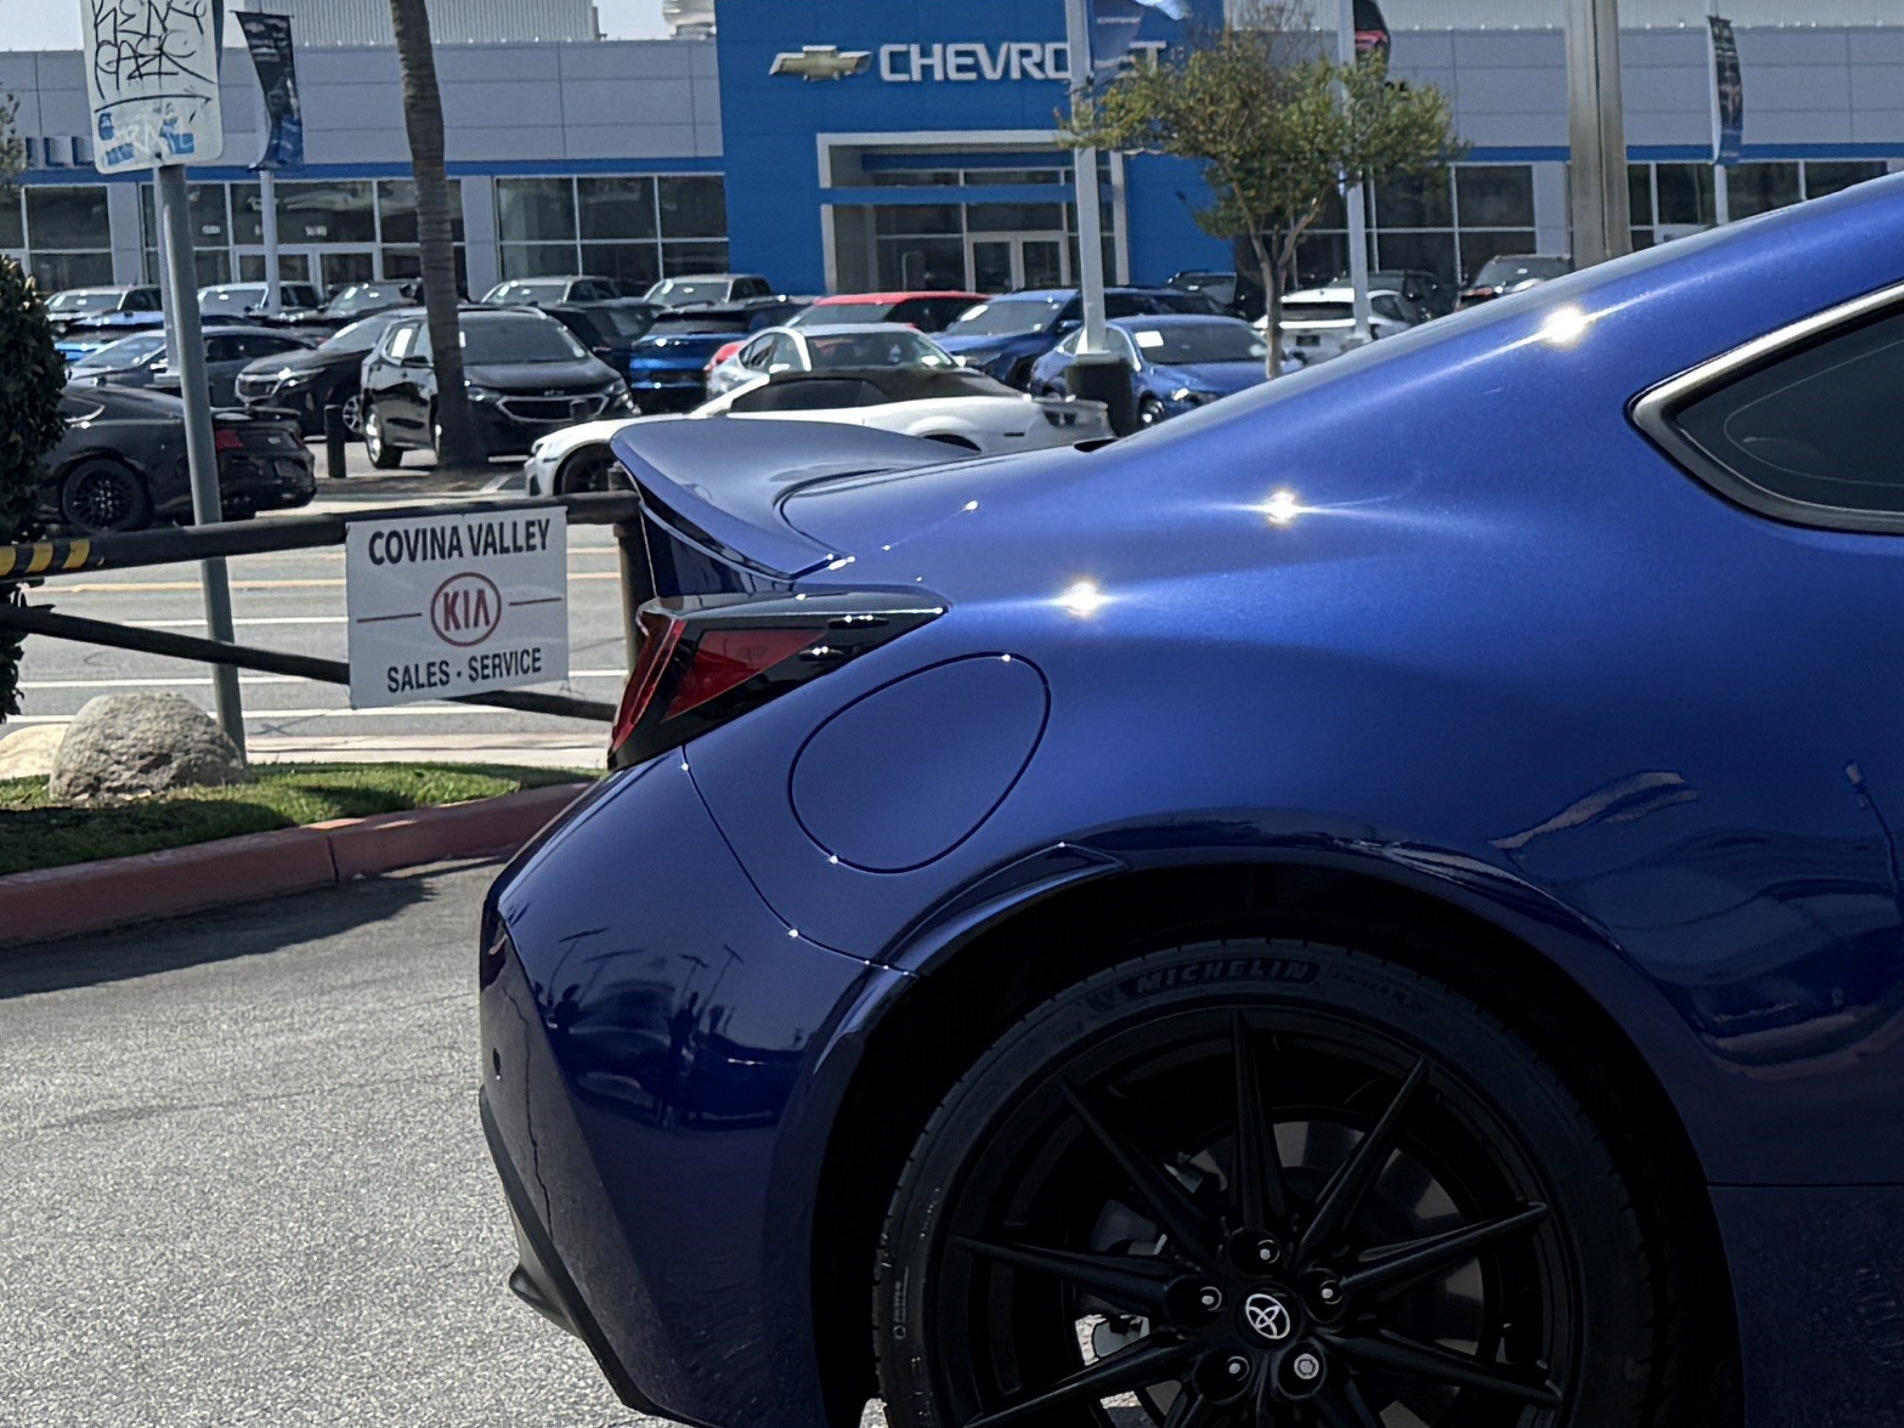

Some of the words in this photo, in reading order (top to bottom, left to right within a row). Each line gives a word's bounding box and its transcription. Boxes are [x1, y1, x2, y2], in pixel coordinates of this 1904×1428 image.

[879, 40, 1168, 82] CHEVROT
[368, 526, 464, 566] COVINA
[467, 518, 550, 557] VALLEY
[443, 588, 491, 632] KIA
[387, 660, 450, 694] SALES
[468, 647, 542, 683] SERVICE
[1134, 960, 1312, 996] MICHELIN
